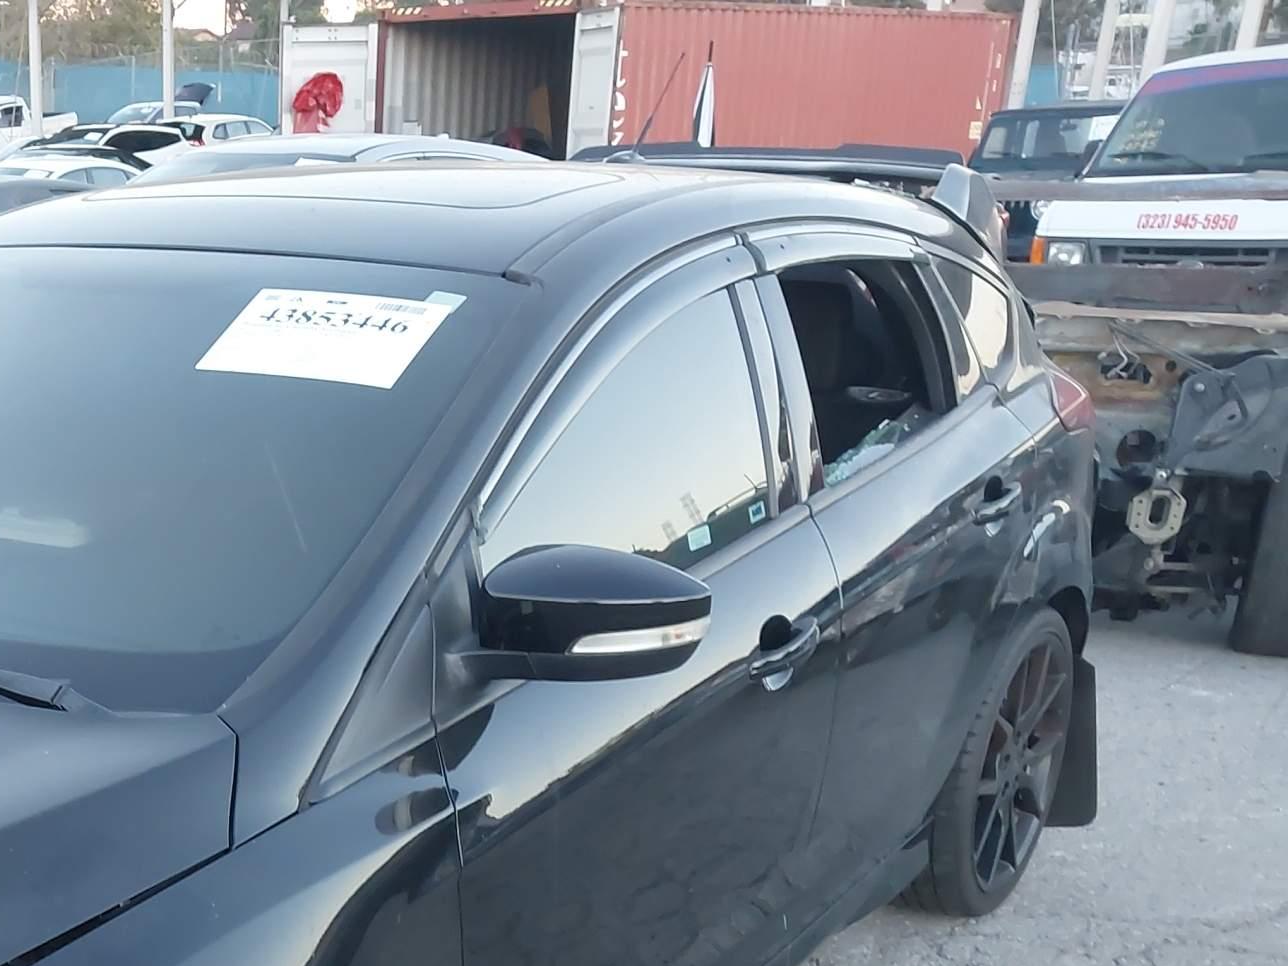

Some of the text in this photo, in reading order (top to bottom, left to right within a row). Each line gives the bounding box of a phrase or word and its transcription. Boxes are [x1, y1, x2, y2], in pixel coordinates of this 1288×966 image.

[1136, 213, 1239, 231] (323) 945-5950
[259, 307, 409, 334] 43853446
